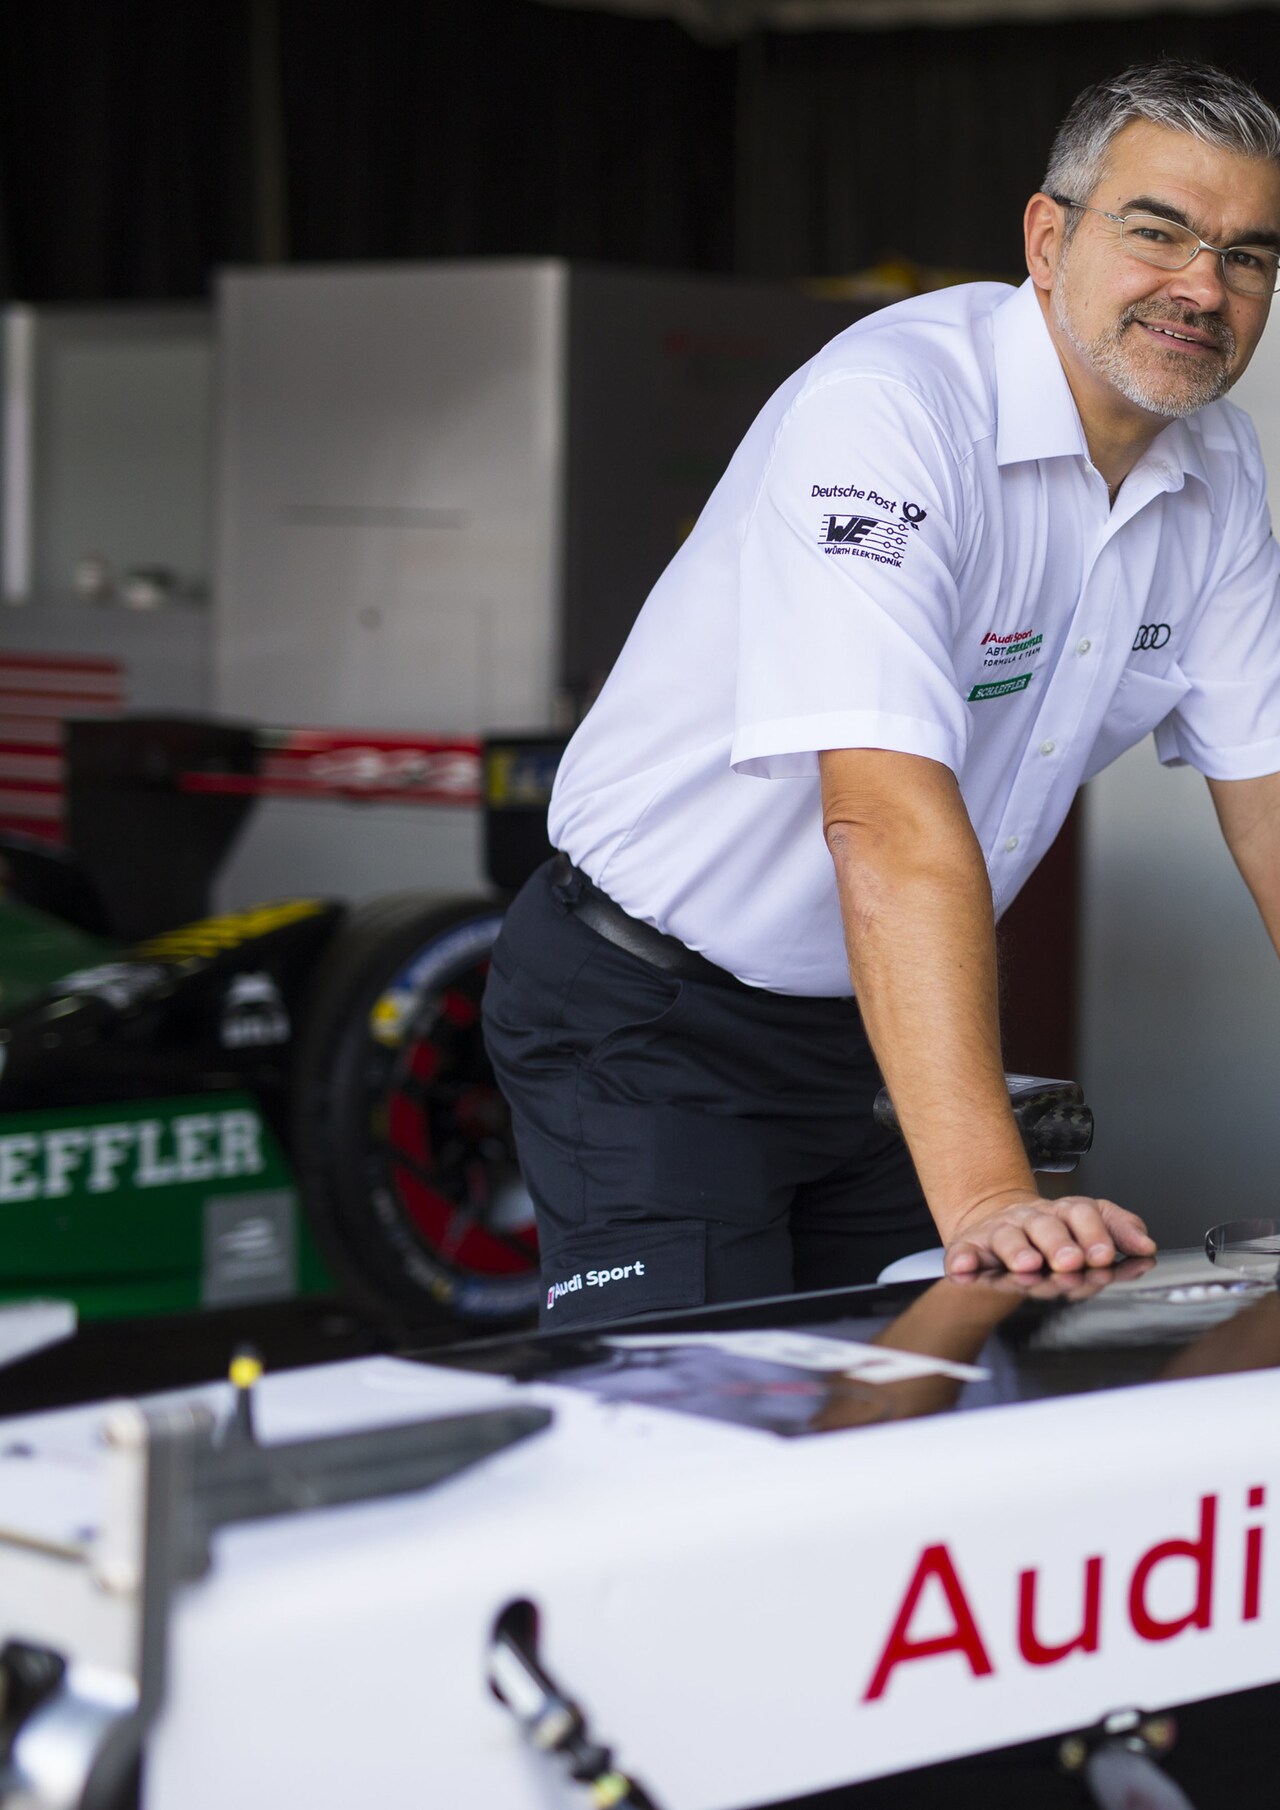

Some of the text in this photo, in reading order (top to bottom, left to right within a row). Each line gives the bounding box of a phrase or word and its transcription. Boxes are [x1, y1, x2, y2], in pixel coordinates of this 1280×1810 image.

[811, 484, 897, 513] Deutsche Post
[824, 545, 902, 568] WÜRTH ELEKTRONIK
[988, 630, 1032, 644] Audi Sport
[986, 646, 1006, 656] ABT
[555, 1261, 645, 1299] Audi Sport
[861, 1484, 1267, 1705] Audi
